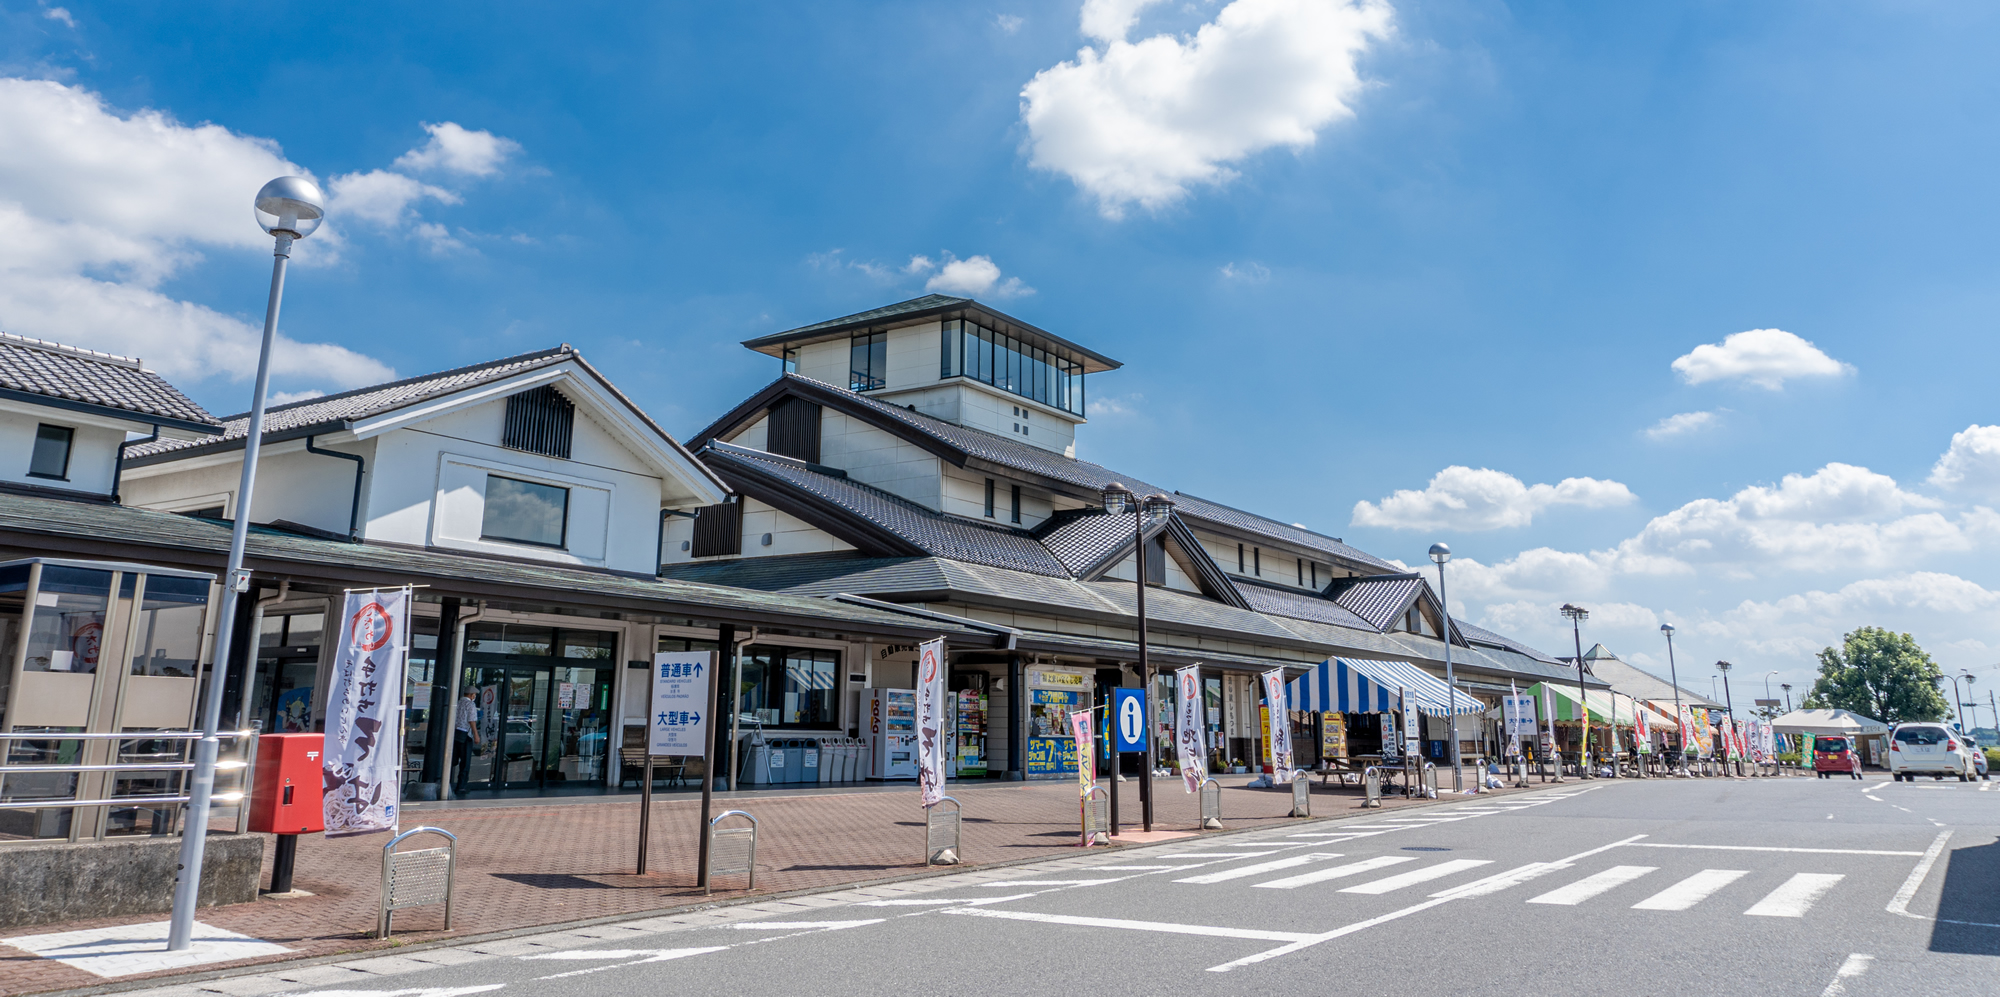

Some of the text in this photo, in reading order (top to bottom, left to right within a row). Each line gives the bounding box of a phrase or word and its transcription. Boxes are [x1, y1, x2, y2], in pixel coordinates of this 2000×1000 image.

[660, 663, 692, 678] 普通車
[657, 711, 689, 726] 大型車
[872, 699, 881, 734] DyDo
